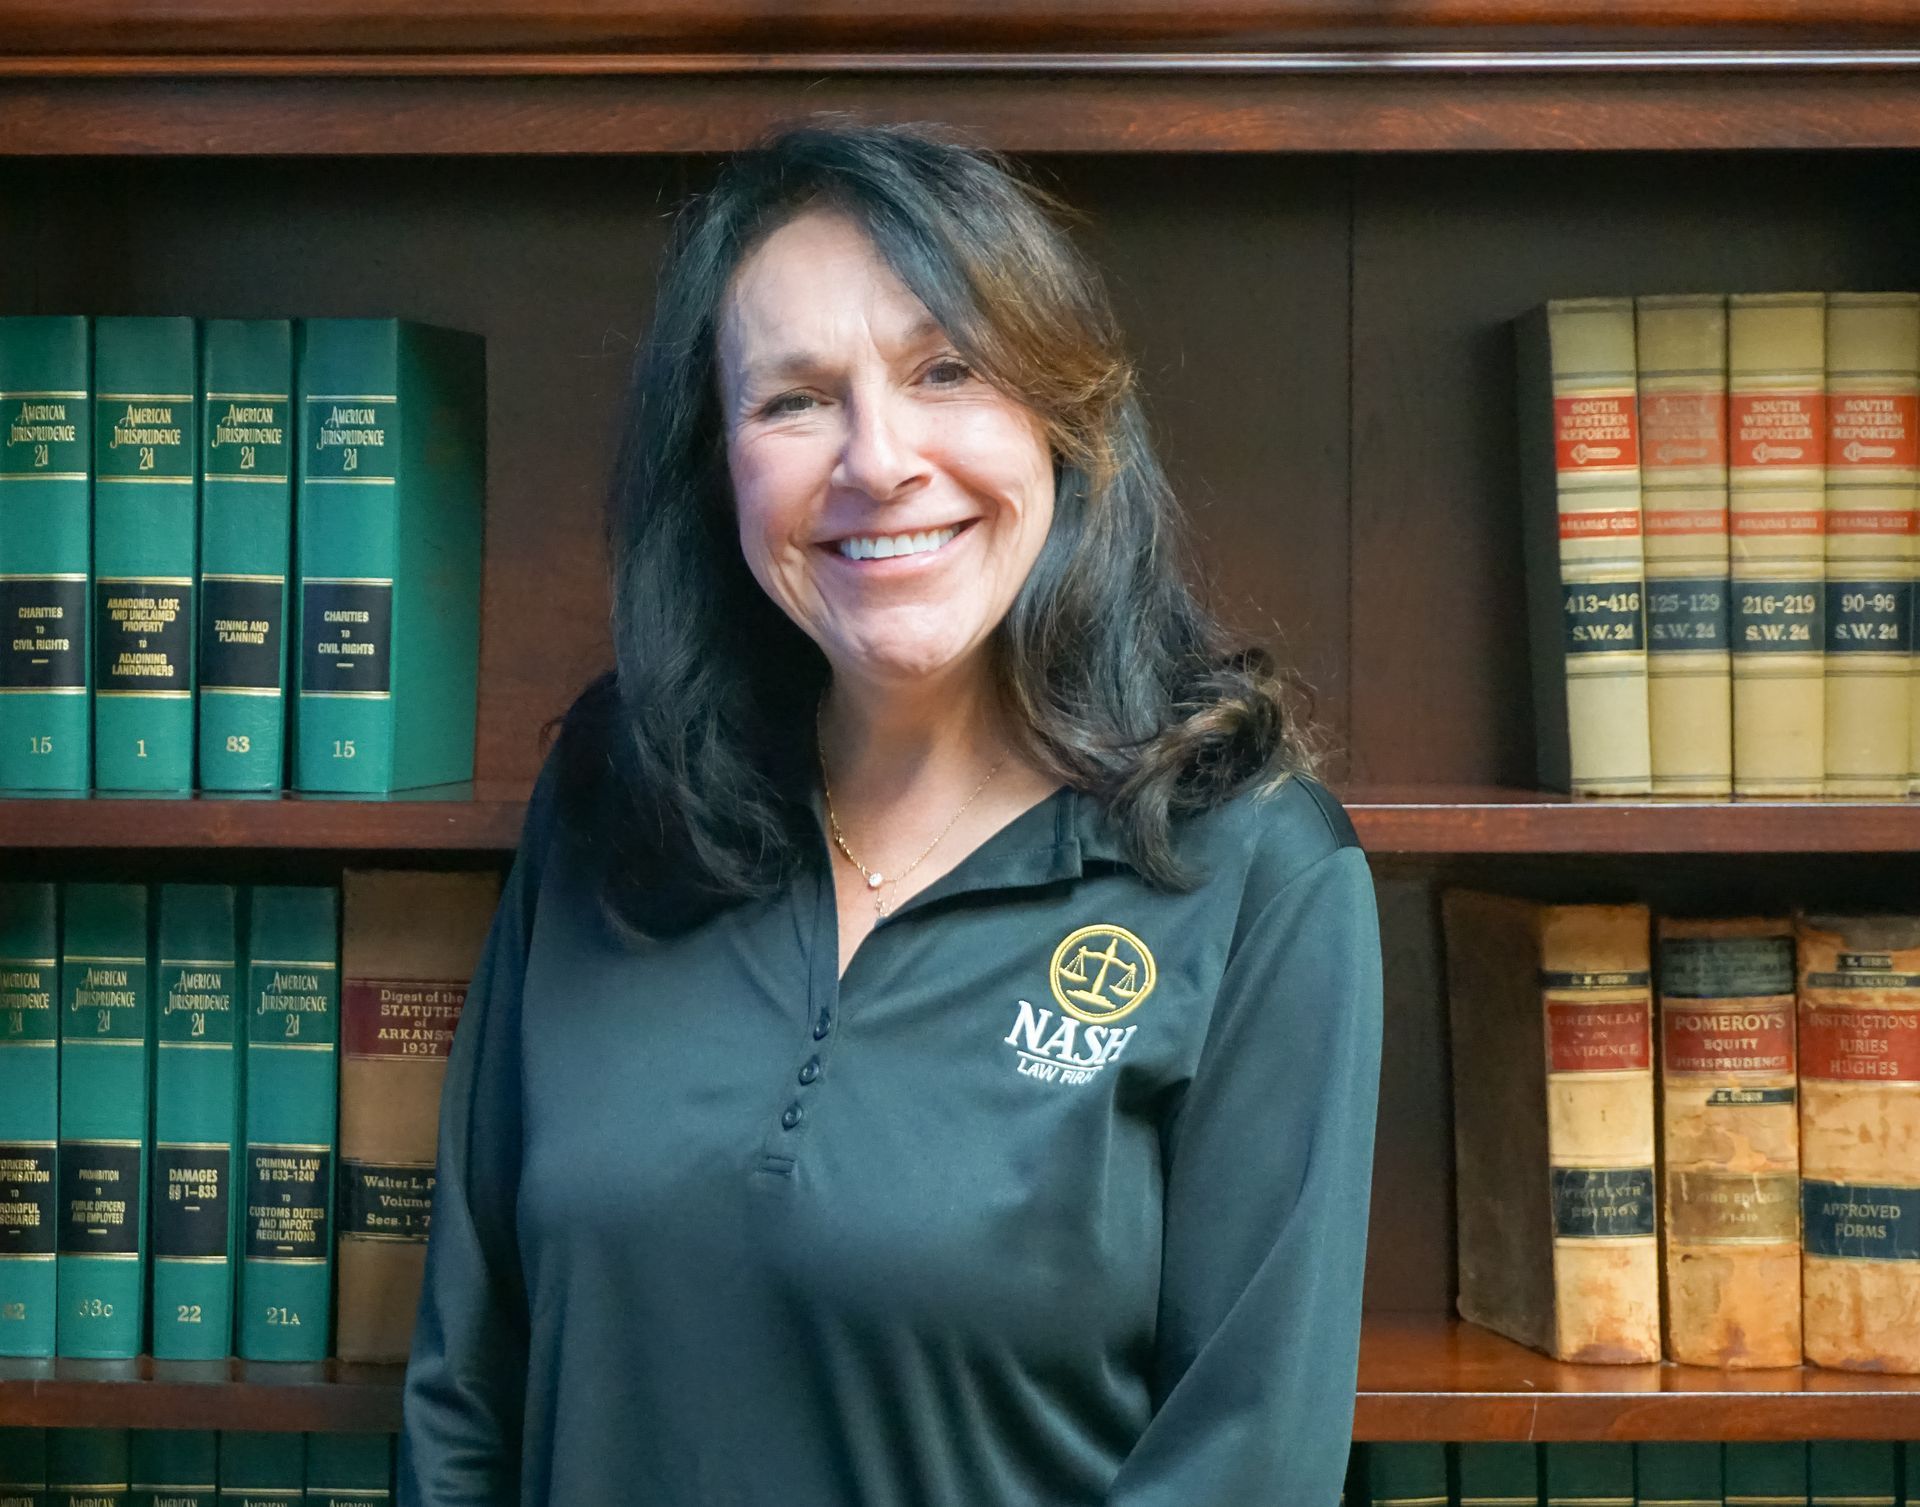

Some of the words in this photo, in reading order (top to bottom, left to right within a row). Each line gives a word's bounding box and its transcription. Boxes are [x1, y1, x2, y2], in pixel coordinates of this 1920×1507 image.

[16, 402, 65, 424] AMERICAN
[1571, 401, 1619, 413] SOUTH
[1752, 400, 1800, 413] SOUTH
[1844, 400, 1894, 412] SOUTH
[119, 404, 172, 427] AMERICAN
[221, 404, 273, 426] AMERICAN
[325, 406, 375, 428] AMERICAN
[1743, 413, 1811, 426] WESTERN
[1834, 412, 1903, 426] WESTERN
[7, 424, 75, 447] JURISPRUDENCE
[110, 426, 181, 448] JURISPRUDENCE
[211, 425, 282, 448] JURISPRUDENCE
[316, 427, 384, 449] JURISPRUDENCE
[1740, 427, 1813, 440] REPORTER
[1832, 426, 1905, 439] REPORTER
[35, 445, 48, 467] 2d
[139, 448, 154, 470] 2d
[240, 446, 255, 469] 2d
[343, 448, 357, 471] 2d
[158, 598, 180, 611] LOST,
[1565, 593, 1640, 613] 413-416
[1650, 594, 1720, 613] 125-129
[1743, 594, 1816, 614] 216-219
[1842, 593, 1895, 613] 90-96
[18, 607, 63, 618] CHARITIES
[111, 609, 128, 620] AND
[130, 609, 176, 621] UNCLAIMED
[324, 611, 369, 623] CHARITIES
[35, 626, 45, 634] TO
[122, 621, 164, 632] PROPERTY
[214, 620, 248, 632] ZONING
[250, 621, 269, 633] AND
[341, 630, 350, 638] TO
[13, 639, 34, 650] CIVIL
[36, 639, 70, 651] RIGHTS
[138, 640, 147, 648] TO
[219, 632, 264, 644] PLANNING
[318, 643, 340, 654] CIVIL
[341, 643, 375, 655] RIGHTS
[119, 653, 167, 664] ADJOINING
[112, 664, 174, 676] LANDOWNERS
[30, 736, 52, 754] 15
[136, 739, 147, 758] 1
[226, 736, 250, 753] 83
[332, 740, 356, 758] 15
[0, 972, 40, 988] MERICAN
[81, 967, 127, 989] AMERICAN
[174, 970, 221, 992] AMERICAN
[267, 971, 318, 993] AMERICAN
[72, 987, 135, 1011] JURISPRUDENCE
[165, 991, 230, 1014] JURISPRUDENCE
[257, 991, 327, 1014] JURISPRUDENCE
[381, 989, 422, 1004] Digest
[425, 991, 439, 1003] of
[443, 993, 464, 1003] the
[381, 1004, 462, 1018] STATUTES
[97, 1009, 110, 1032] 2d
[192, 1012, 205, 1035] 2d
[285, 1014, 299, 1037] 2d
[414, 1018, 427, 1028] of
[1675, 1013, 1785, 1032] POMEROY'S
[1810, 1013, 1918, 1029] INSTRUCTIONS
[1004, 1001, 1138, 1067] NASH
[402, 1042, 438, 1054] 1937
[1704, 1038, 1759, 1051] EQUITY
[1017, 1058, 1059, 1083] LAW
[1830, 1060, 1899, 1076] HUGHES
[0, 1159, 38, 1170] ORKERS'
[256, 1157, 297, 1169] CRIMINAL
[300, 1159, 320, 1171] LAW
[169, 1168, 218, 1183] DAMAGES
[364, 1176, 408, 1190] Walter
[411, 1177, 424, 1189] L.
[11, 1189, 19, 1198] TO
[282, 1194, 291, 1202] TO
[0, 1203, 40, 1213] RONGFUL
[95, 1201, 125, 1213] OFFICERS
[380, 1195, 432, 1208] Volume
[249, 1206, 290, 1218] CUSTOMS
[292, 1207, 324, 1219] DUTIES
[1823, 1202, 1901, 1219] APPROVED
[0, 1214, 40, 1225] SCHARGE
[87, 1212, 124, 1225] EMPLOYEES
[258, 1219, 277, 1229] AND
[279, 1219, 314, 1231] IMPORT
[256, 1230, 316, 1242] REGULATIONS
[1835, 1223, 1887, 1239] FORMS
[177, 1305, 202, 1322] 22
